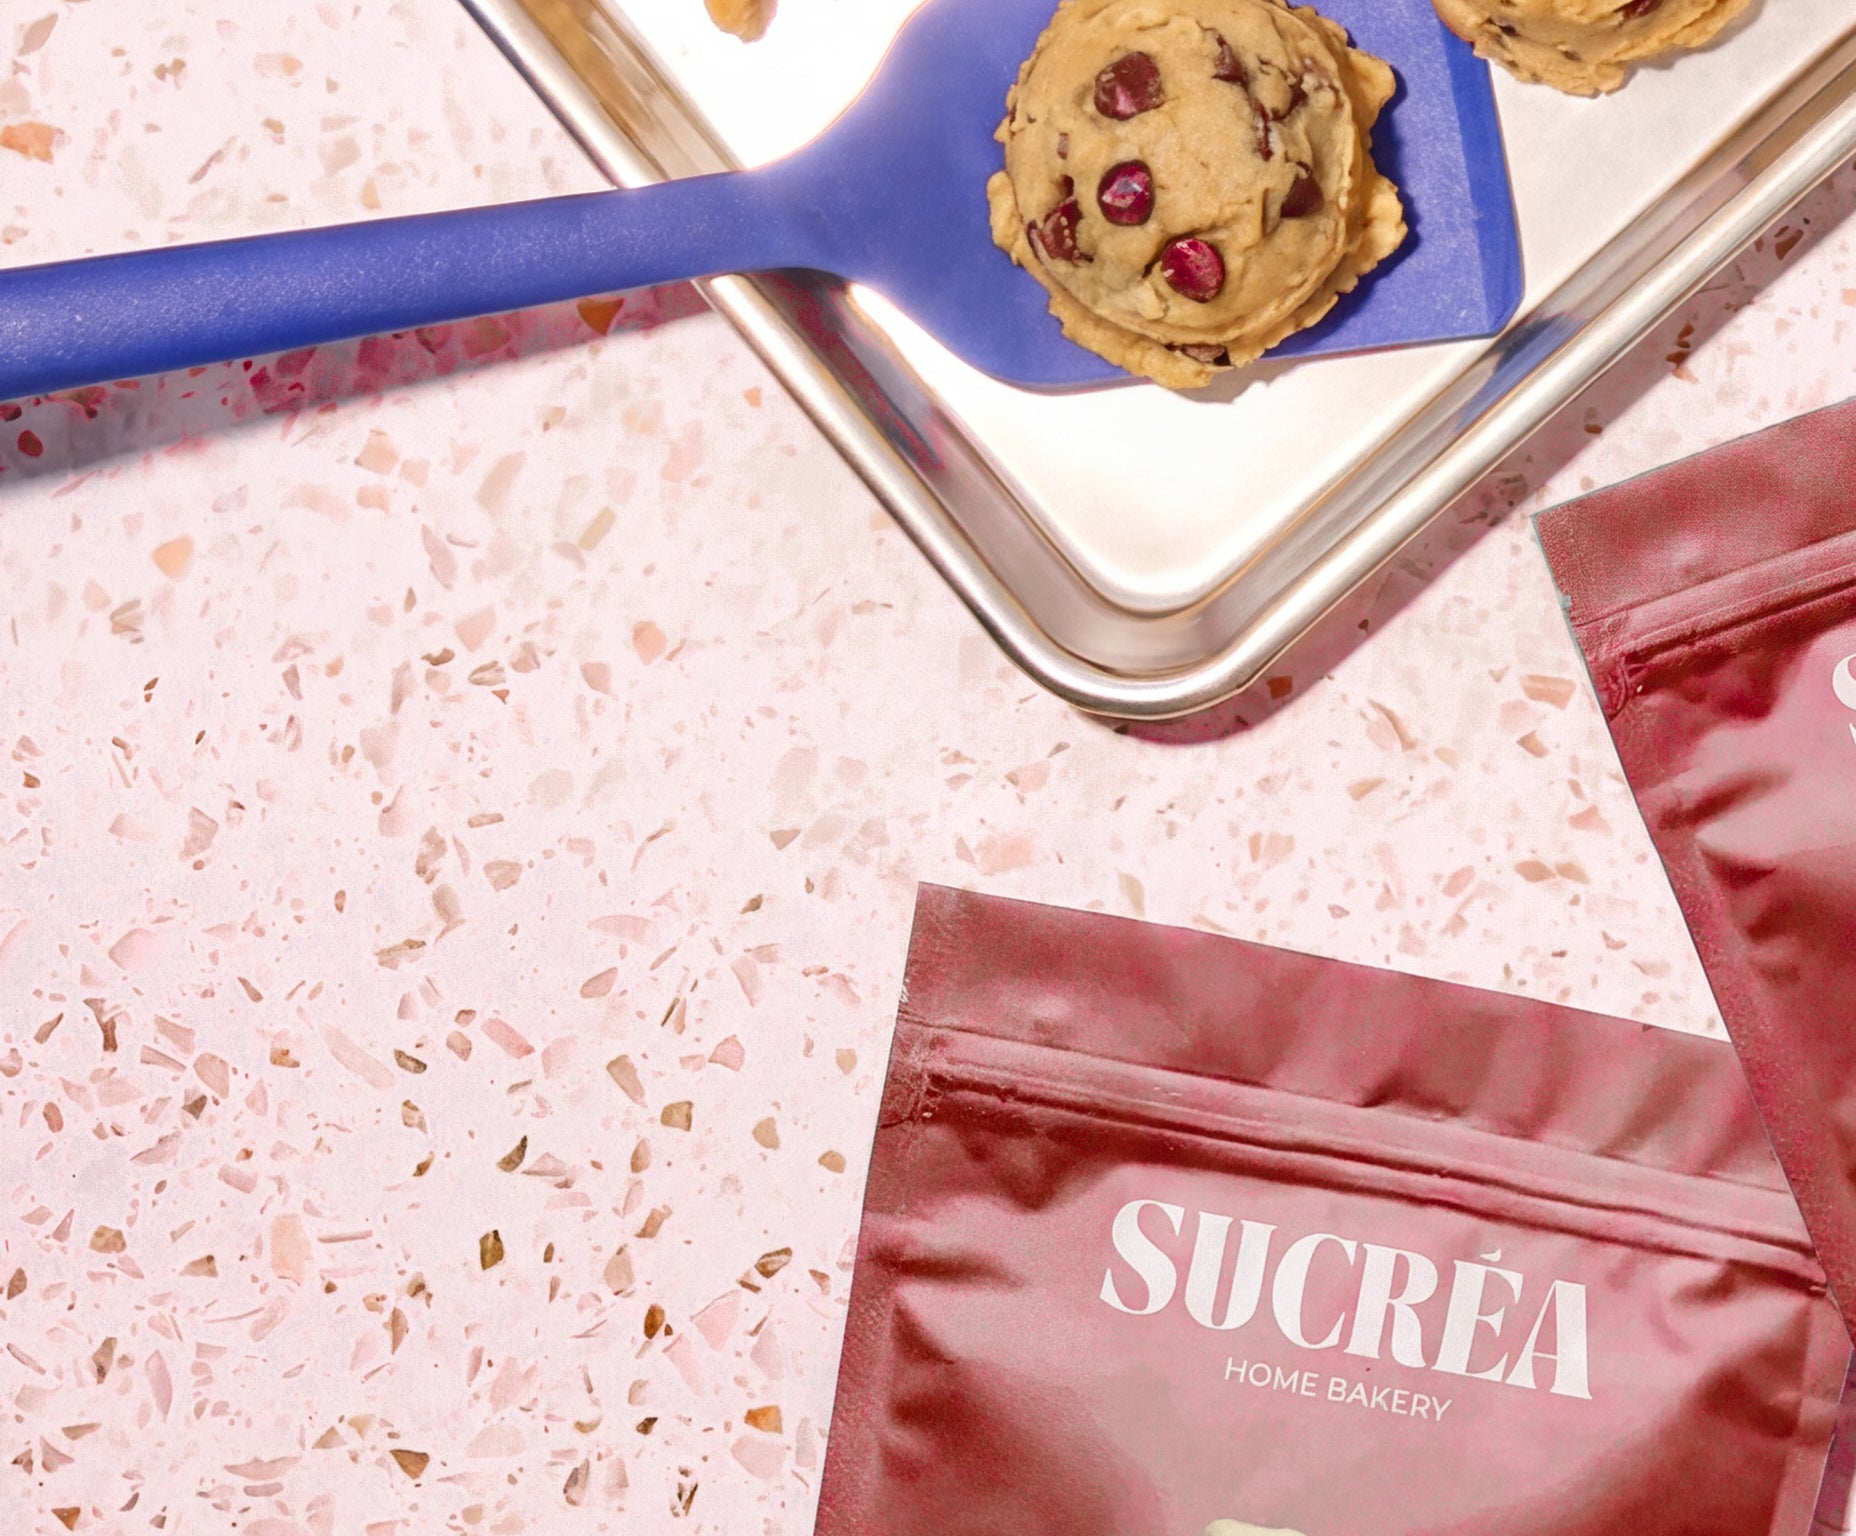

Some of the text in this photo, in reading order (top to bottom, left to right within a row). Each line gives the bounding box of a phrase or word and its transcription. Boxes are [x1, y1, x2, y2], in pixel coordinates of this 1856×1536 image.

[1099, 1199, 1593, 1400] SUCRÉA
[1224, 1357, 1452, 1421] HOME BAKERY
